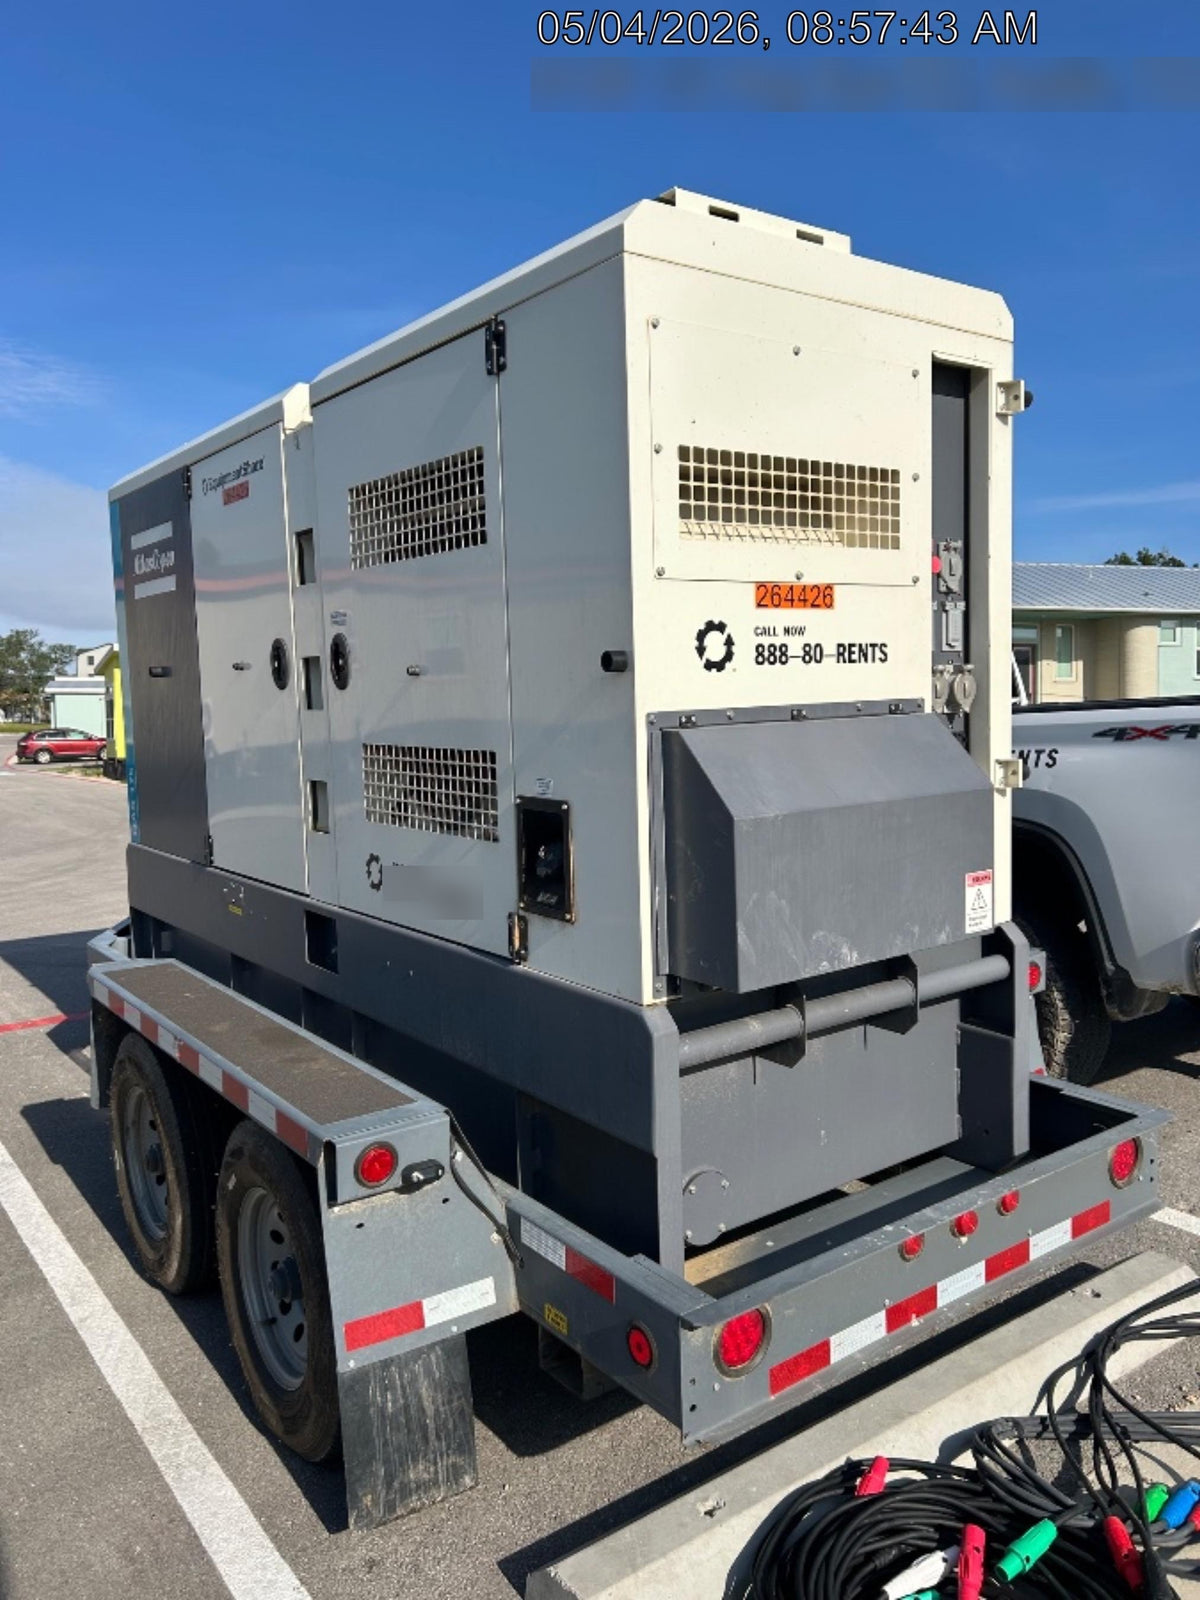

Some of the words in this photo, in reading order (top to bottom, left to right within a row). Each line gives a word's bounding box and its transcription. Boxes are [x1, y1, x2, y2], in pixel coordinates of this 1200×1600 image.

[756, 584, 834, 609] 264426
[754, 626, 779, 637] CALL
[783, 625, 807, 637] NOW
[1012, 748, 1060, 769] NTS
